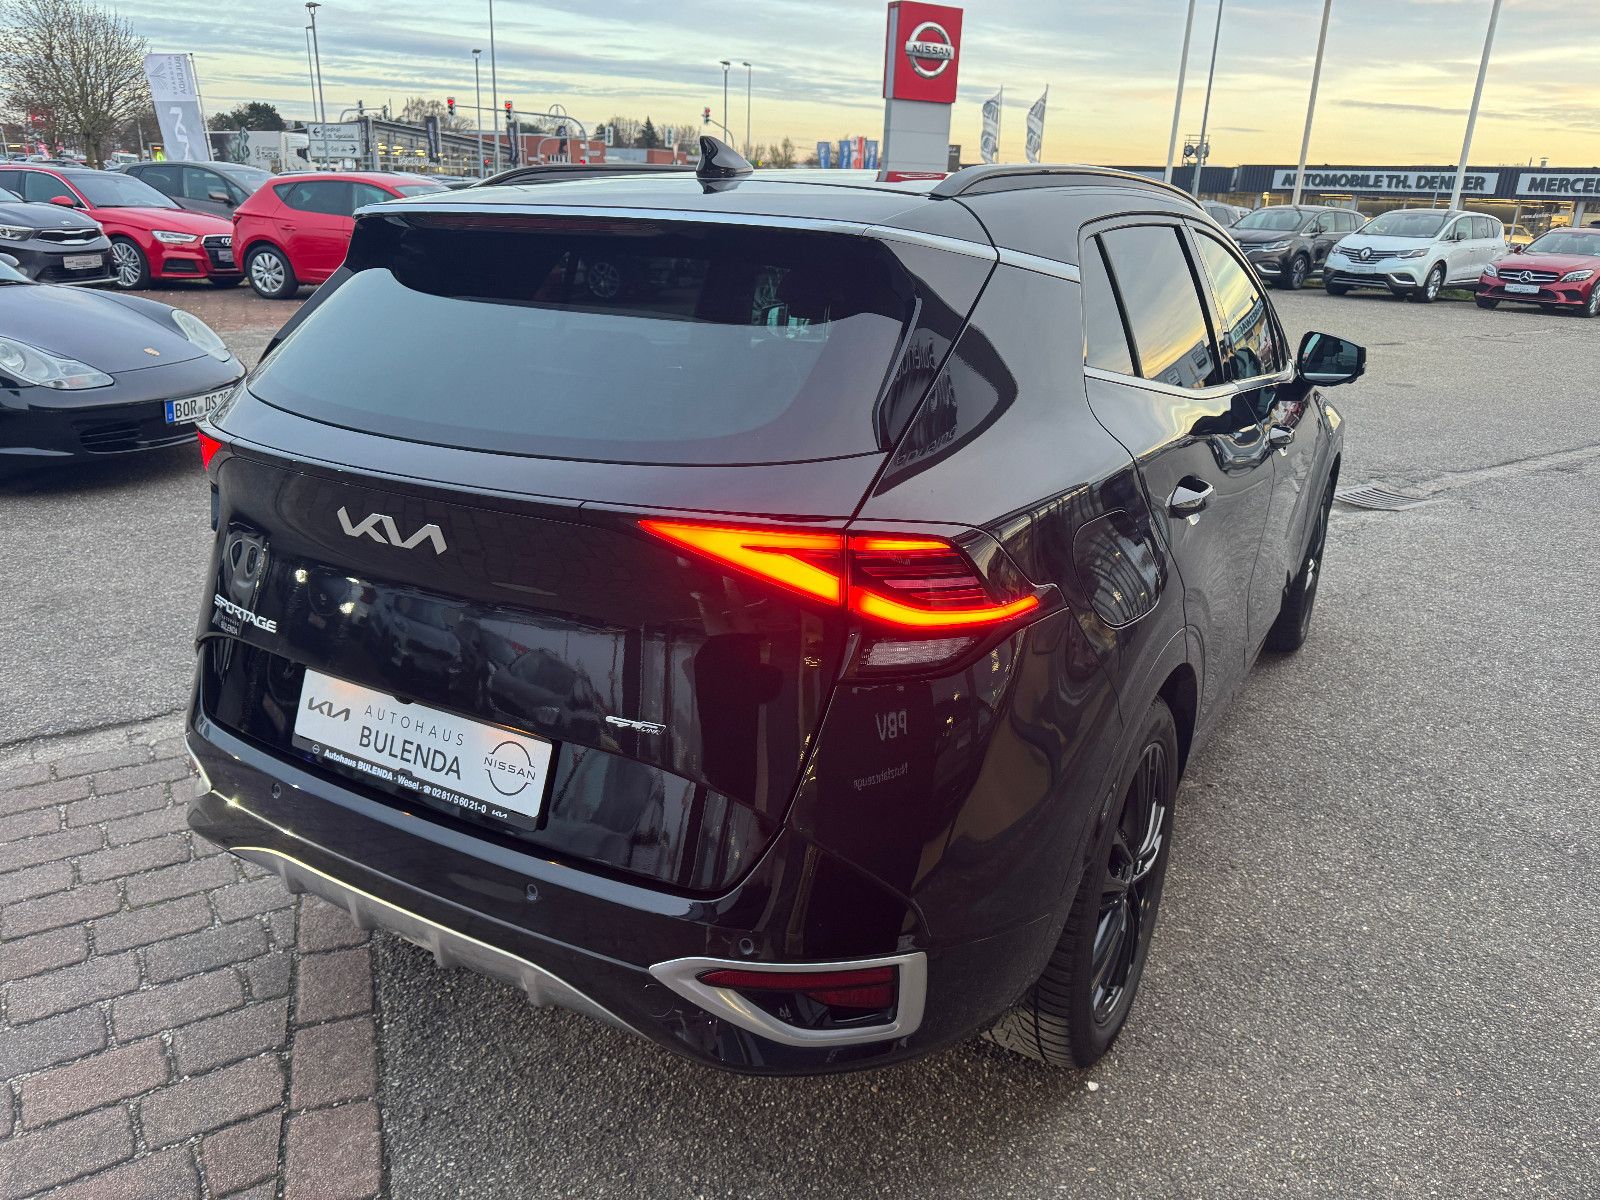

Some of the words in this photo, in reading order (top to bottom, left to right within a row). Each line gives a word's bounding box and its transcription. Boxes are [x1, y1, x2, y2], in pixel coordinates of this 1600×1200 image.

[912, 44, 952, 57] NISSAN
[1385, 174, 1412, 189] TH.
[174, 399, 198, 419] BOR
[204, 395, 217, 412] DS
[337, 506, 448, 556] KIA
[214, 593, 277, 634] SPORTAGE
[307, 696, 351, 722] KIA
[364, 704, 464, 746] AUTOHAUS
[324, 749, 357, 768] Autohaus
[357, 760, 393, 781] BULENDA
[397, 774, 420, 790] Wesel
[358, 725, 461, 781] BULENDA
[483, 756, 536, 780] NISSAN
